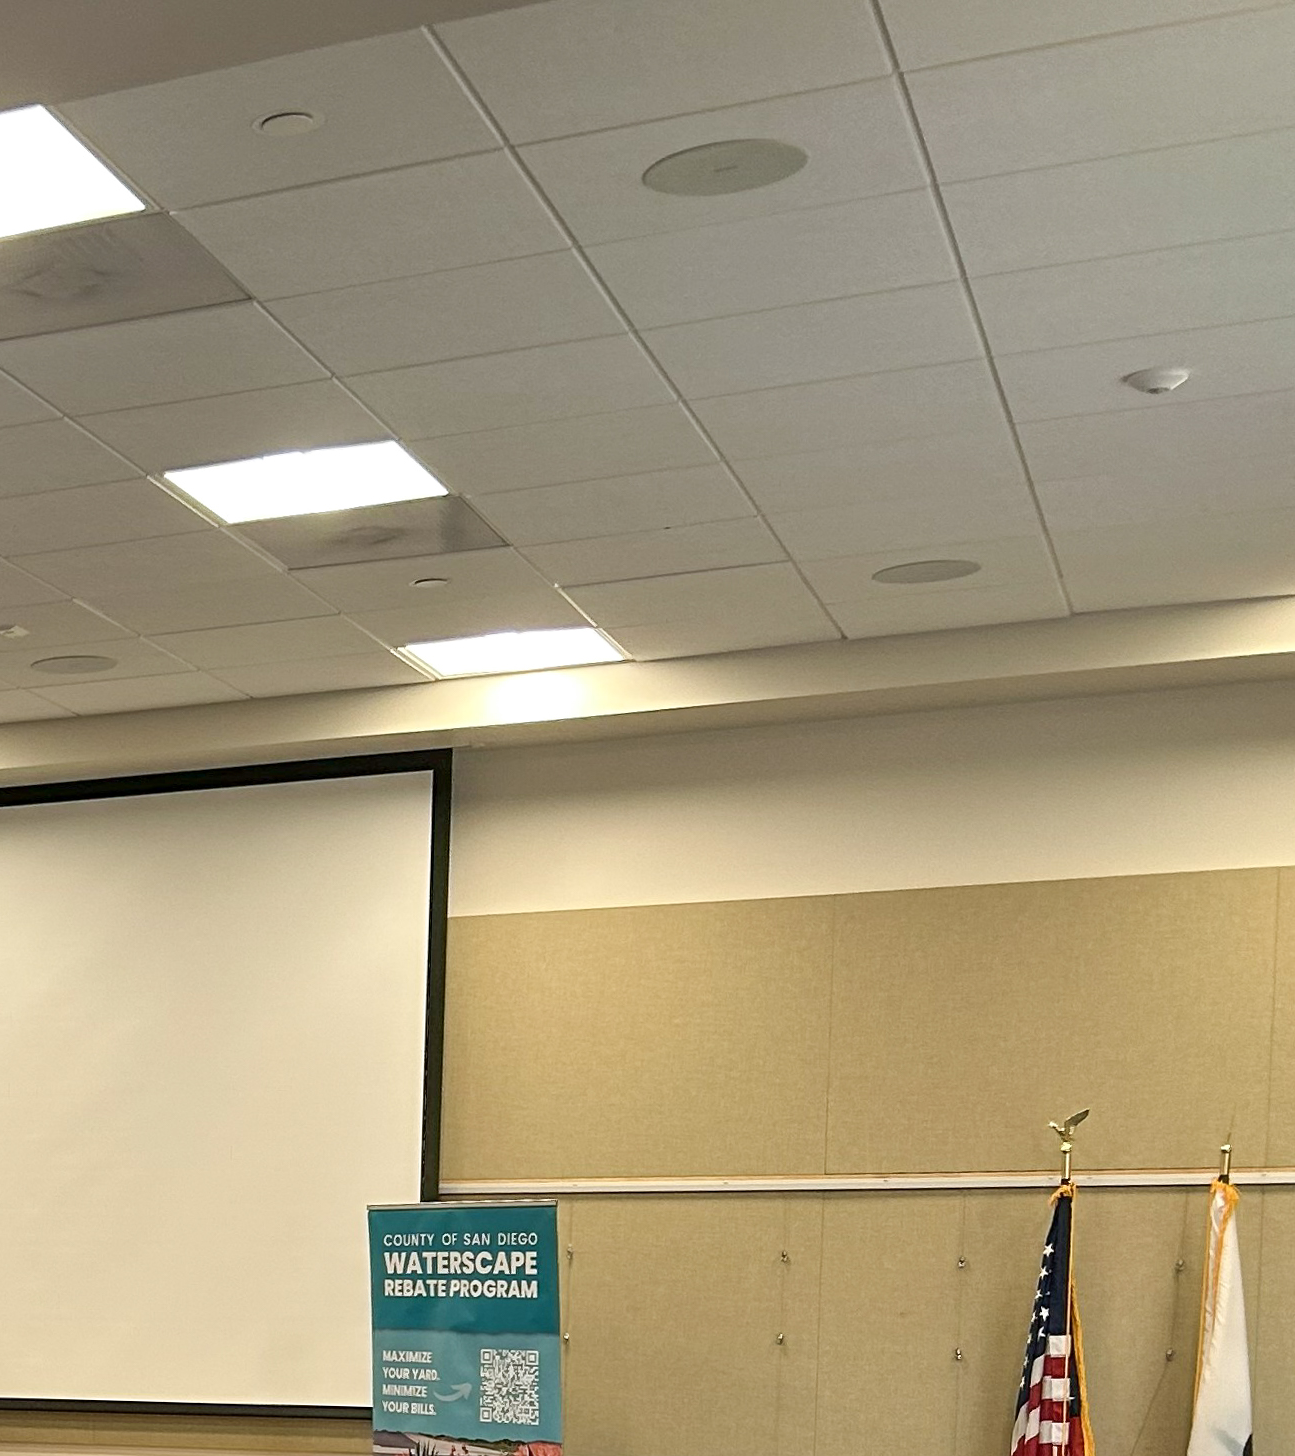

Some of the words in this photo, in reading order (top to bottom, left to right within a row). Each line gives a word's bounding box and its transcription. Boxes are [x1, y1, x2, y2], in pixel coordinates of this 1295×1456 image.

[383, 1233, 435, 1247] COUNTY
[442, 1232, 458, 1246] OF
[463, 1232, 491, 1246] SAN
[497, 1232, 538, 1246] DIEGO
[383, 1251, 538, 1275] WATERSCAPE
[384, 1279, 447, 1297] REBATE
[449, 1280, 538, 1299] PROGRAM
[382, 1350, 432, 1364] MAXIMIZE
[382, 1366, 410, 1380] YOUR
[412, 1368, 441, 1381] YARD.
[382, 1384, 428, 1398] MINIMIZE
[381, 1400, 410, 1414] YOUR
[410, 1402, 437, 1416] BILLS.
